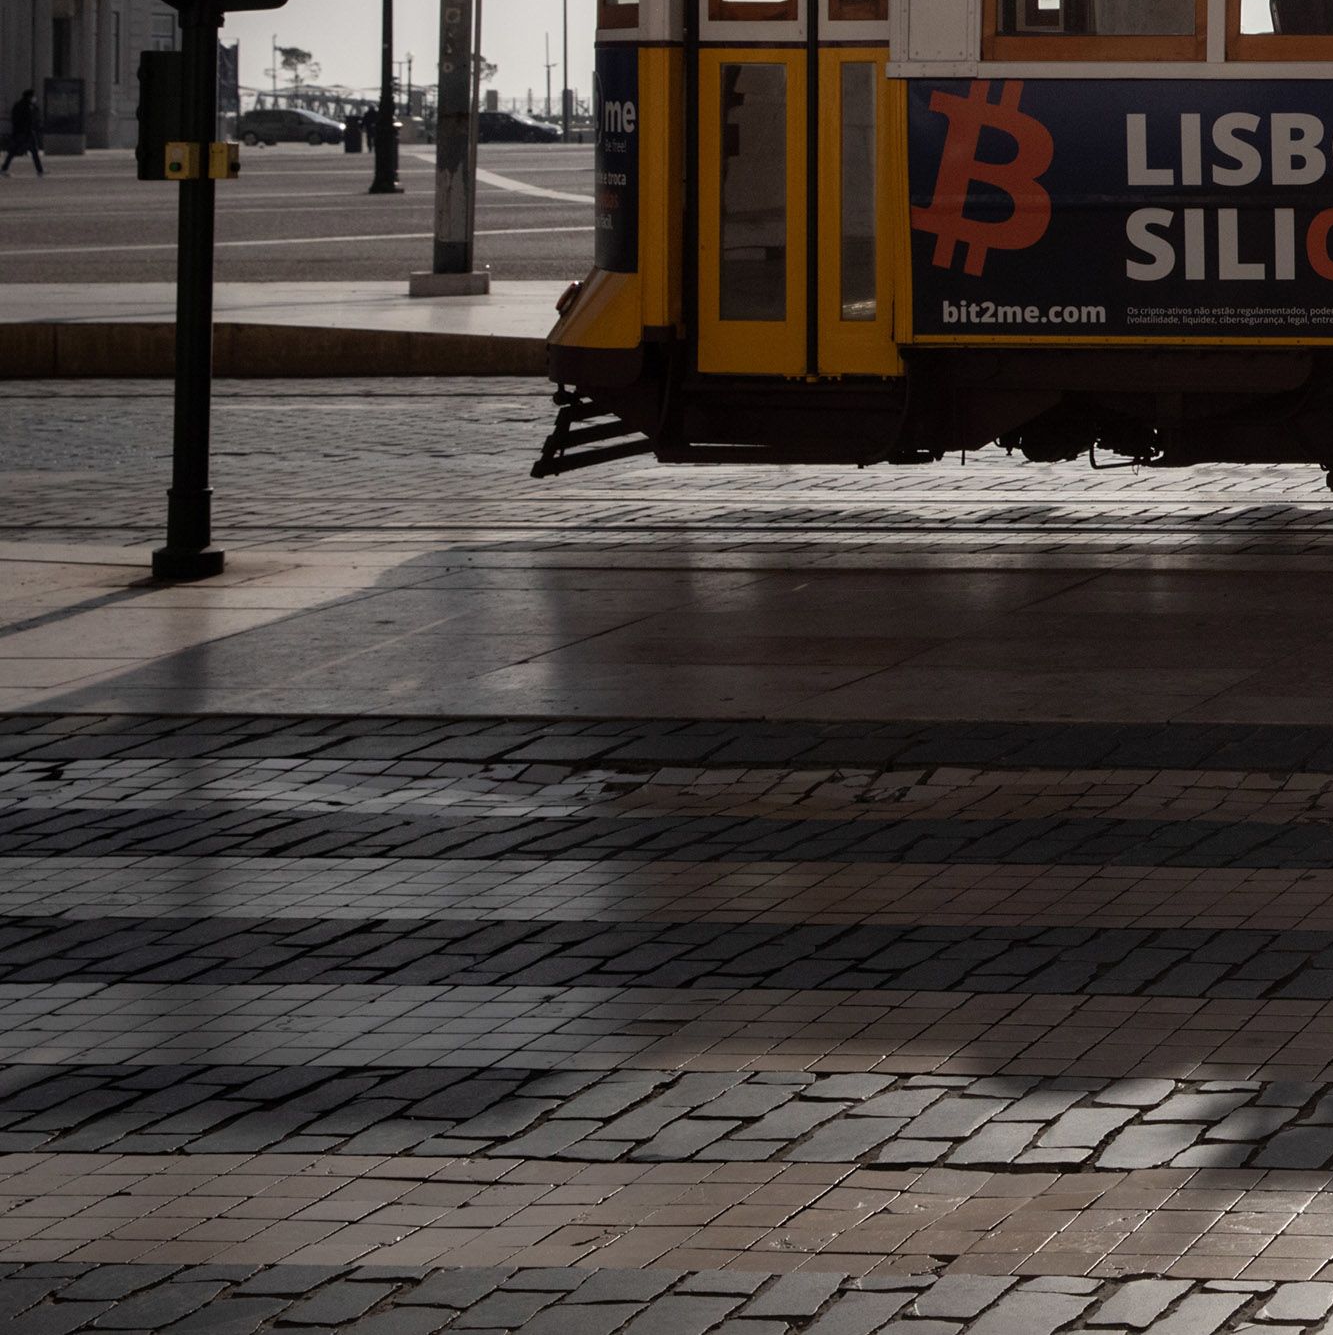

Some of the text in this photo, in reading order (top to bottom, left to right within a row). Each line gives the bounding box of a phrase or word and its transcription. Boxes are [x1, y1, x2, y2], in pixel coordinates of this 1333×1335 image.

[604, 99, 637, 134] me
[942, 299, 1107, 325] bit2me.com
[1140, 306, 1193, 317] cripto-ativos
[1193, 306, 1210, 315] não
[1211, 306, 1235, 315] estão
[1236, 306, 1308, 317] regulamentados,
